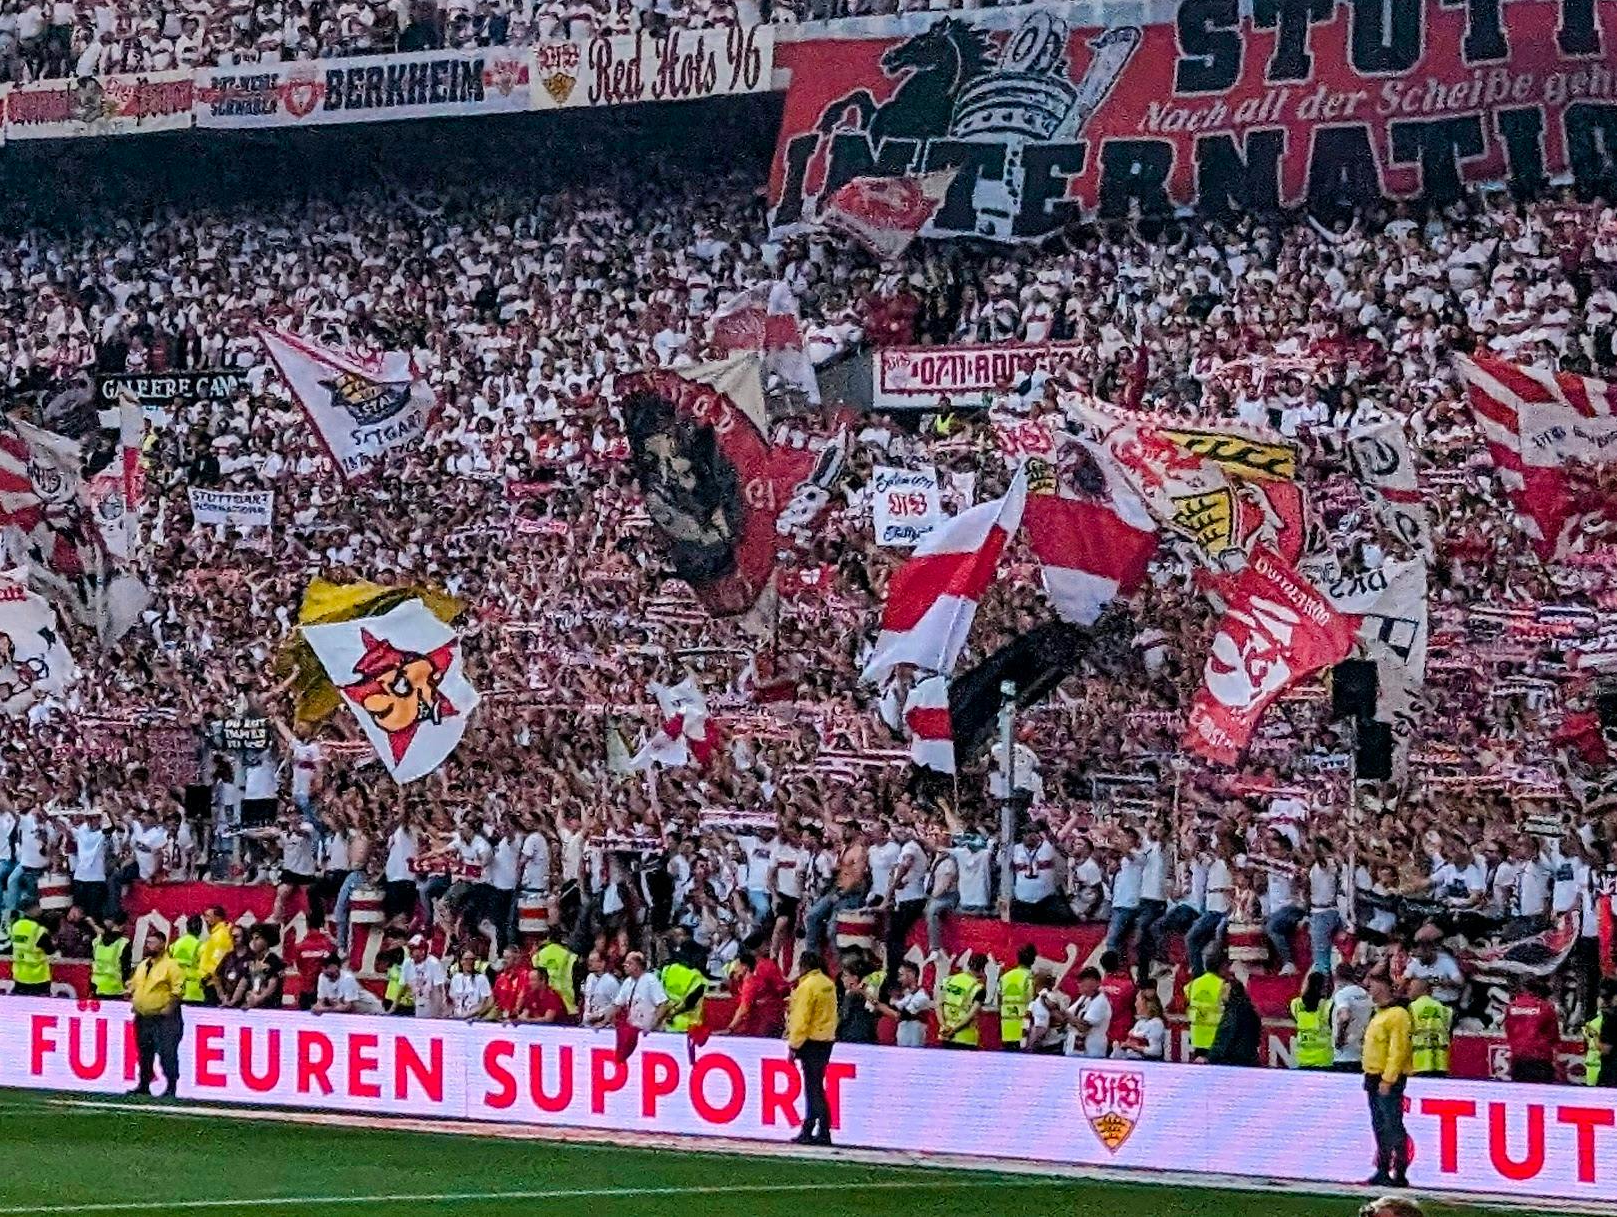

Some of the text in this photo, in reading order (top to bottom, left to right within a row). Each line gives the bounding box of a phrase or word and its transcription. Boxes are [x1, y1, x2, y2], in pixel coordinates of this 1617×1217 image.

[324, 59, 485, 112] BERKHEIM
[589, 28, 645, 106] Red
[727, 25, 761, 91] 96
[1138, 100, 1225, 133] Nach
[1234, 83, 1285, 125] all
[1297, 86, 1368, 120] der
[1381, 68, 1533, 115] Scheiße
[194, 1024, 445, 1102] EUREN
[482, 1039, 857, 1132] SUPPORT
[1376, 1096, 1616, 1183] TUT
